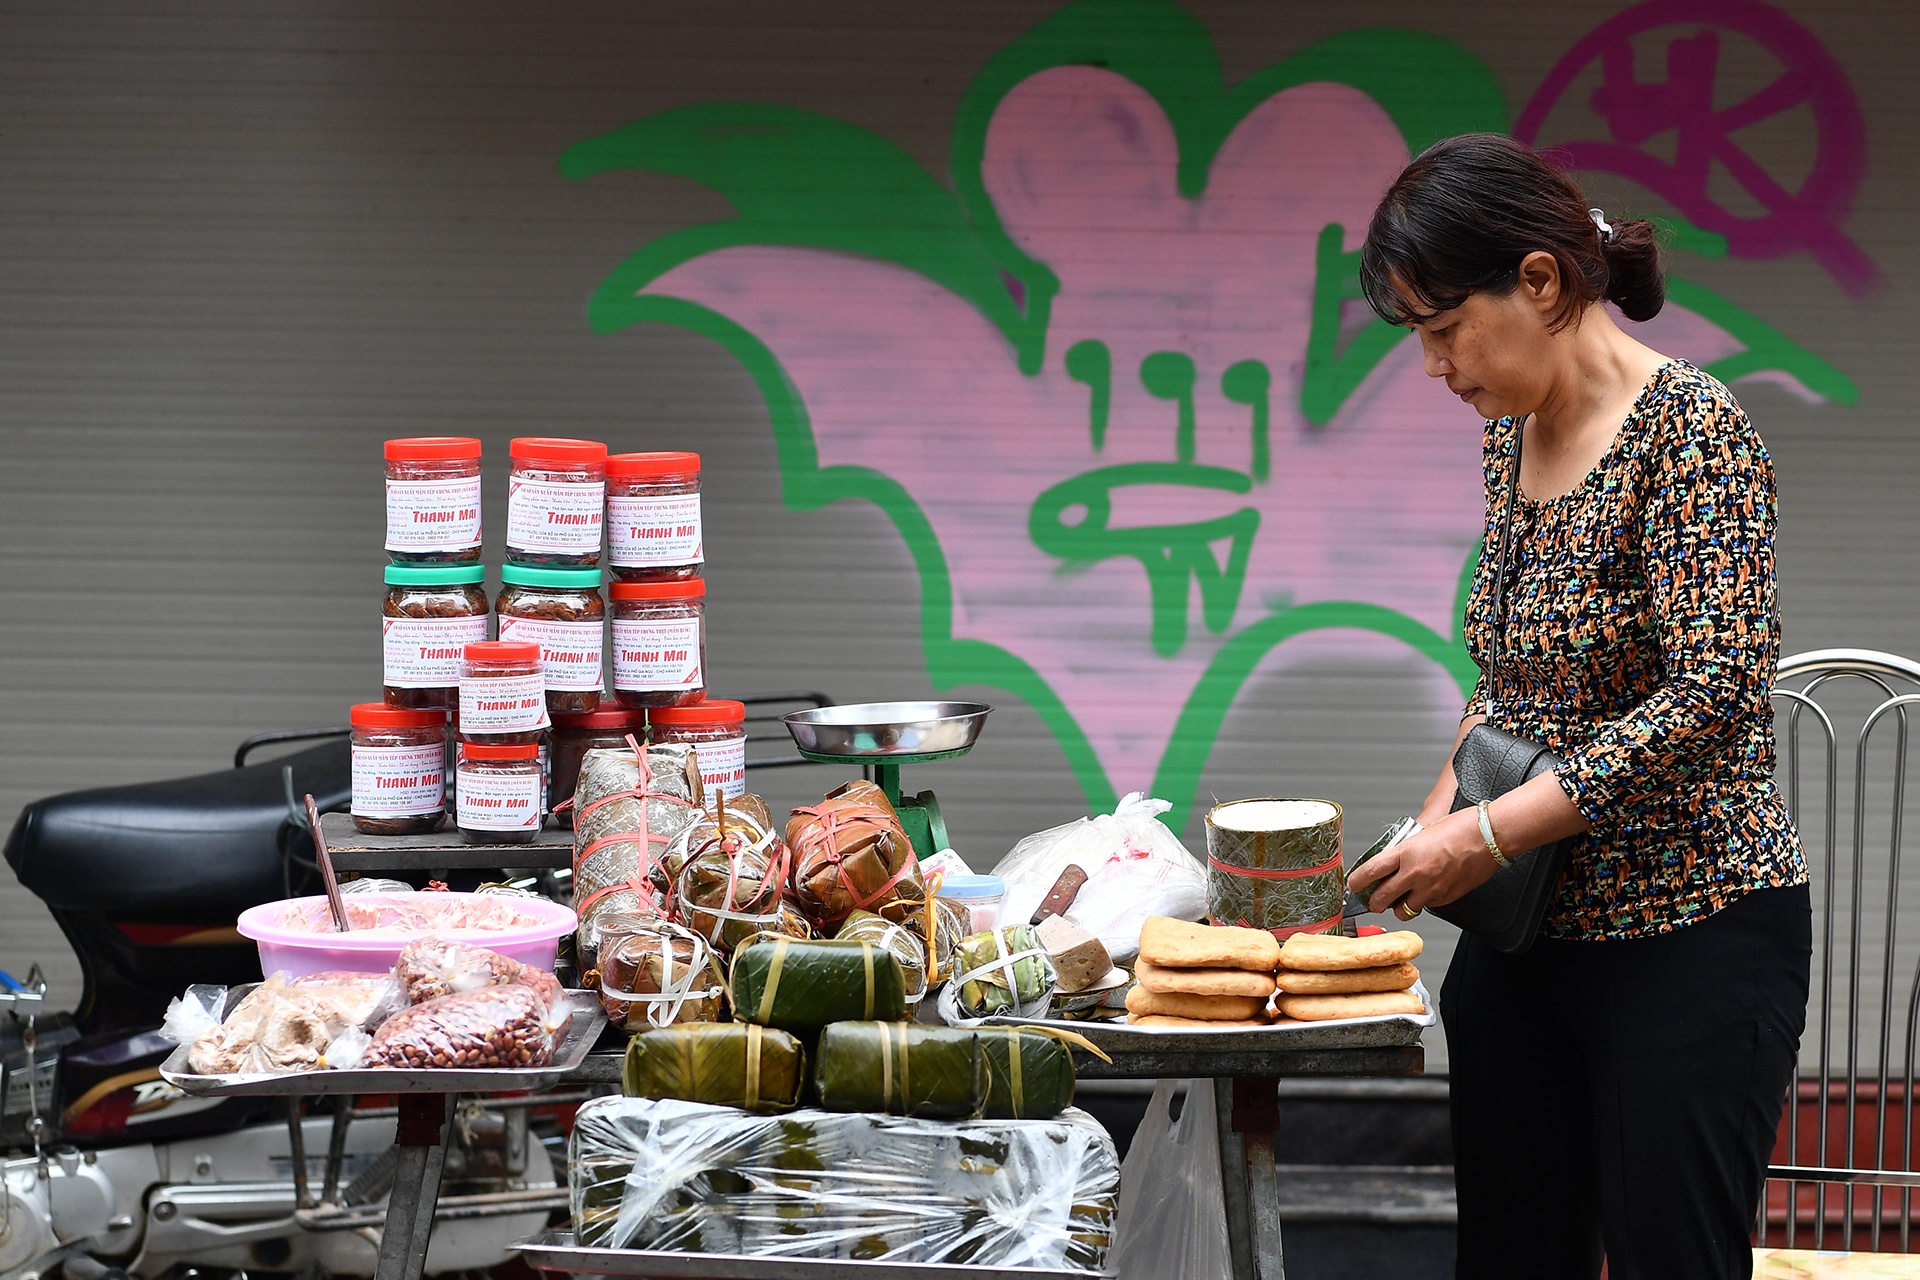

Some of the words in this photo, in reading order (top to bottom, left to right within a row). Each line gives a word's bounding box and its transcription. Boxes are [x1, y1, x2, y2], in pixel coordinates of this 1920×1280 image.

[413, 511, 454, 523] THANH
[459, 509, 476, 520] MAI
[548, 512, 588, 525] THANH
[591, 513, 601, 524] MA
[630, 527, 672, 538] THANH
[677, 526, 695, 537] MAI
[420, 647, 462, 659] THANH
[543, 650, 583, 663] THANH
[622, 650, 659, 662] THANH
[664, 650, 687, 661] MAI
[477, 701, 517, 710] THANH
[521, 698, 539, 708] MAI
[376, 776, 418, 788] THANH
[422, 774, 441, 787] MAI
[701, 772, 730, 785] HANH
[465, 796, 502, 808] THANH
[506, 799, 528, 808] MAI
